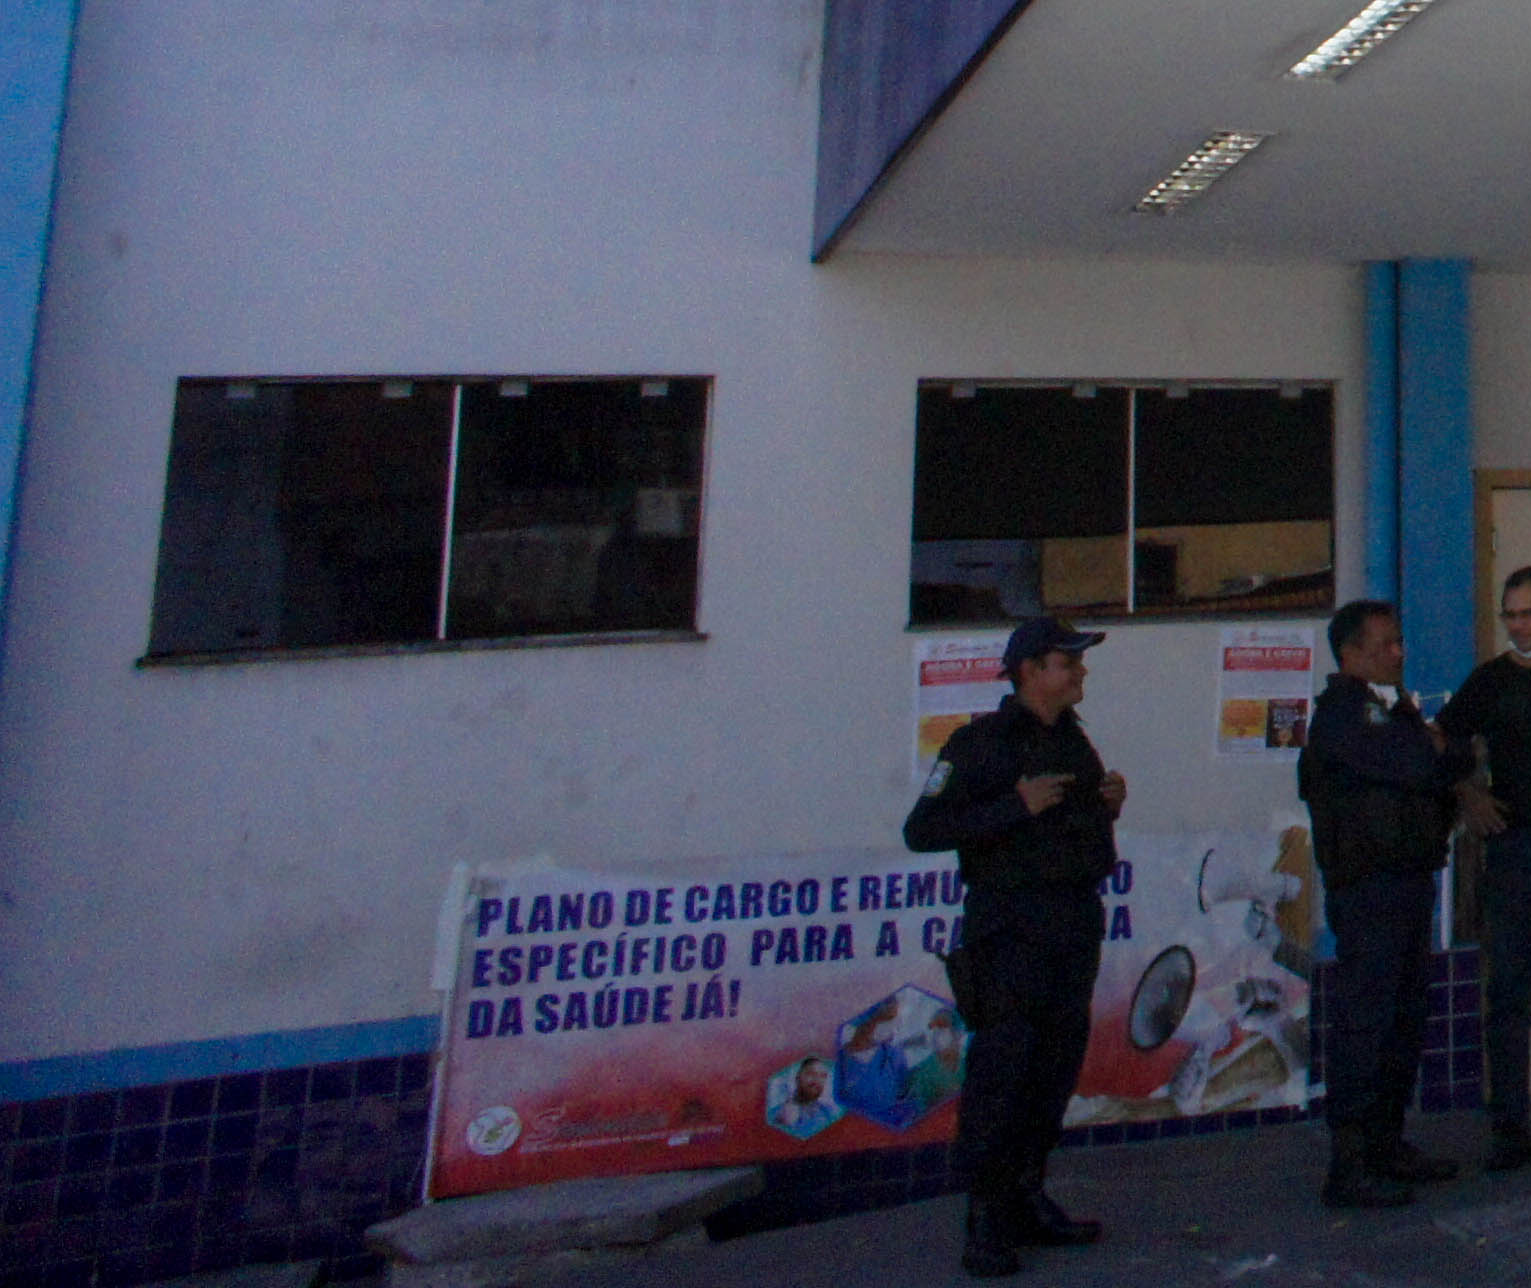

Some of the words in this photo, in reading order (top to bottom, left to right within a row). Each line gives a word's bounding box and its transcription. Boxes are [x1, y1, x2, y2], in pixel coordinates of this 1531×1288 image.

[476, 891, 614, 937] PLANO
[624, 887, 674, 928] DE
[684, 878, 820, 924] CARGO
[830, 876, 850, 914] E
[472, 930, 727, 988] ESPECÍFICO
[750, 923, 854, 967] PARA
[875, 920, 901, 957] A
[466, 996, 523, 1040] DA
[534, 982, 674, 1035] SAÚDE
[681, 973, 743, 1022] JÁ!
